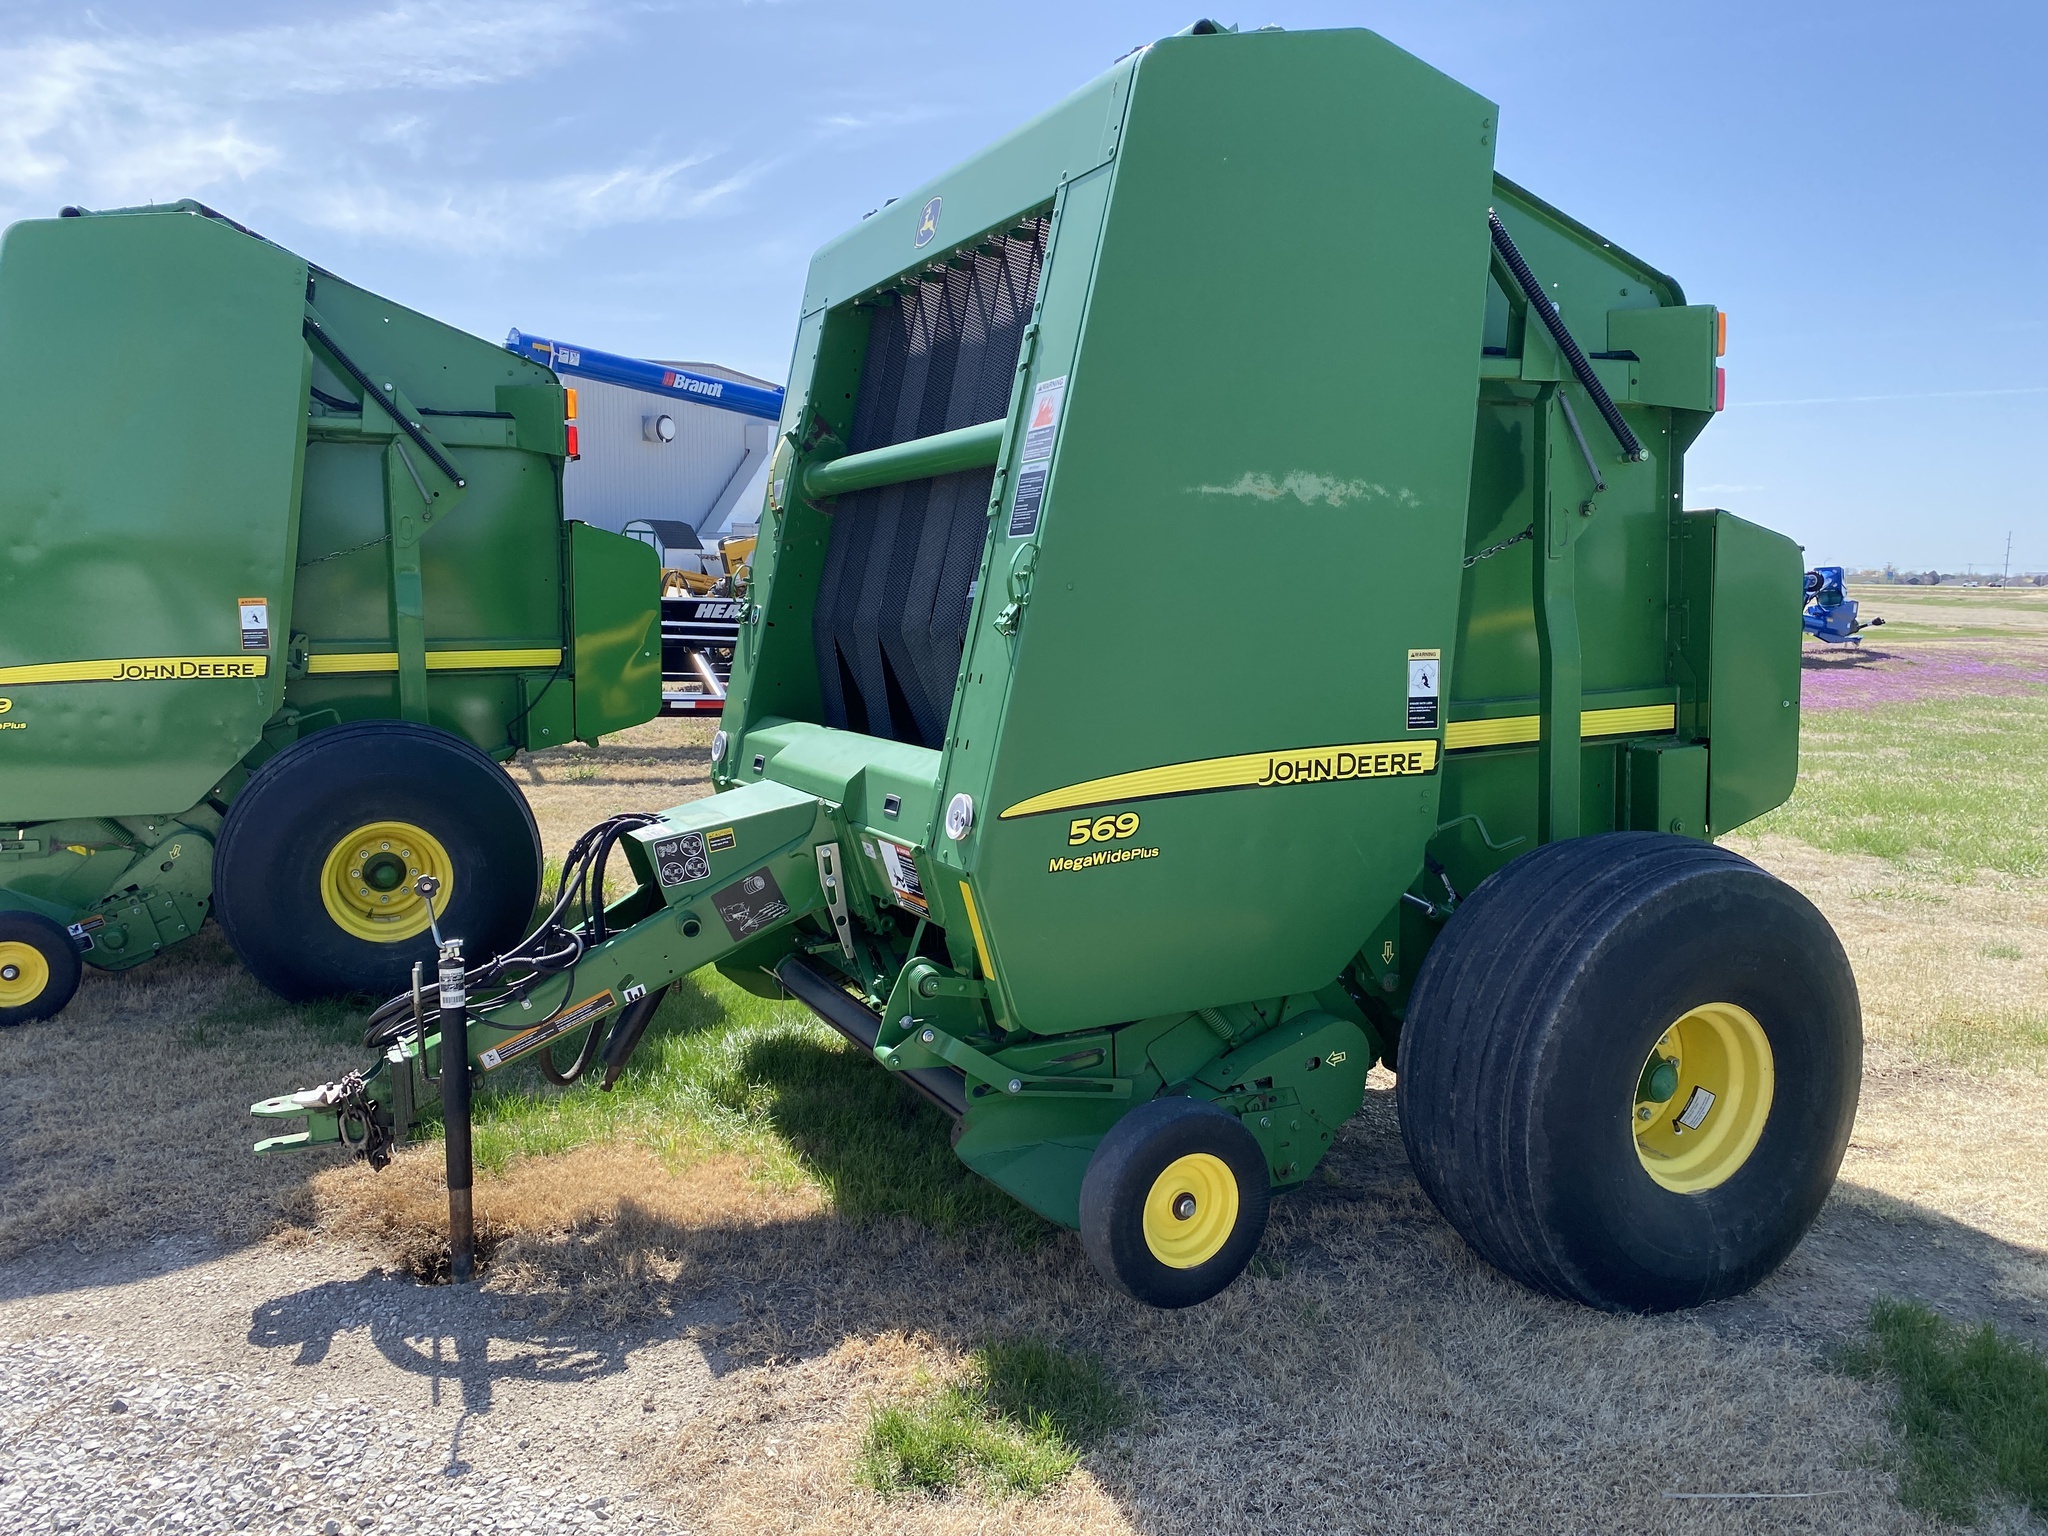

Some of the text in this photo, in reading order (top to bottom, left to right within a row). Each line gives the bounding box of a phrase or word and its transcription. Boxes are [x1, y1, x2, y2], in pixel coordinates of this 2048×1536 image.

[673, 374, 723, 398] Brandt
[113, 662, 255, 679] JOHN DEERE
[1258, 753, 1422, 782] JOHN DEERE
[1069, 812, 1140, 846] 569
[1049, 847, 1160, 873] MegaWidePlus
